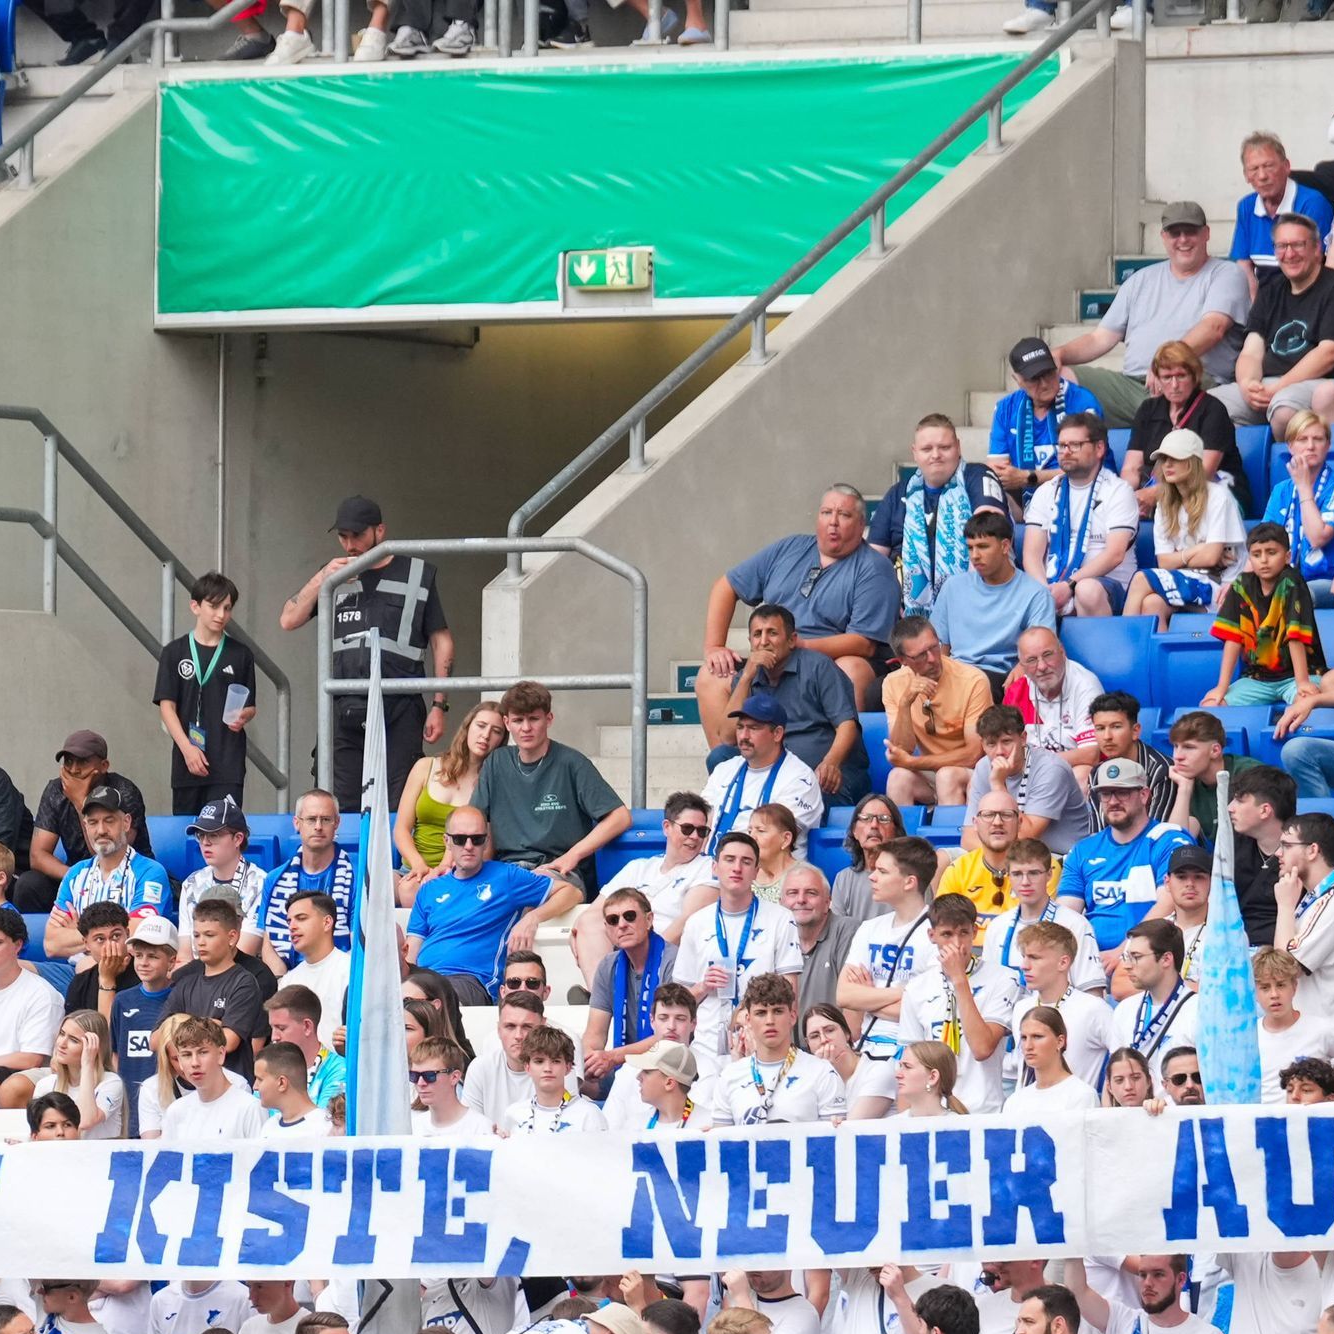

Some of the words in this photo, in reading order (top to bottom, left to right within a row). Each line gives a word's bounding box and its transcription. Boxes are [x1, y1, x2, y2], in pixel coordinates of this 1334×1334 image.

[1022, 349, 1045, 361] WIRSOL
[336, 610, 362, 624] 1578
[867, 943, 914, 973] TSG
[130, 1036, 152, 1051] SA
[94, 1148, 532, 1291] KISTE,
[621, 1126, 1066, 1260] NEUER
